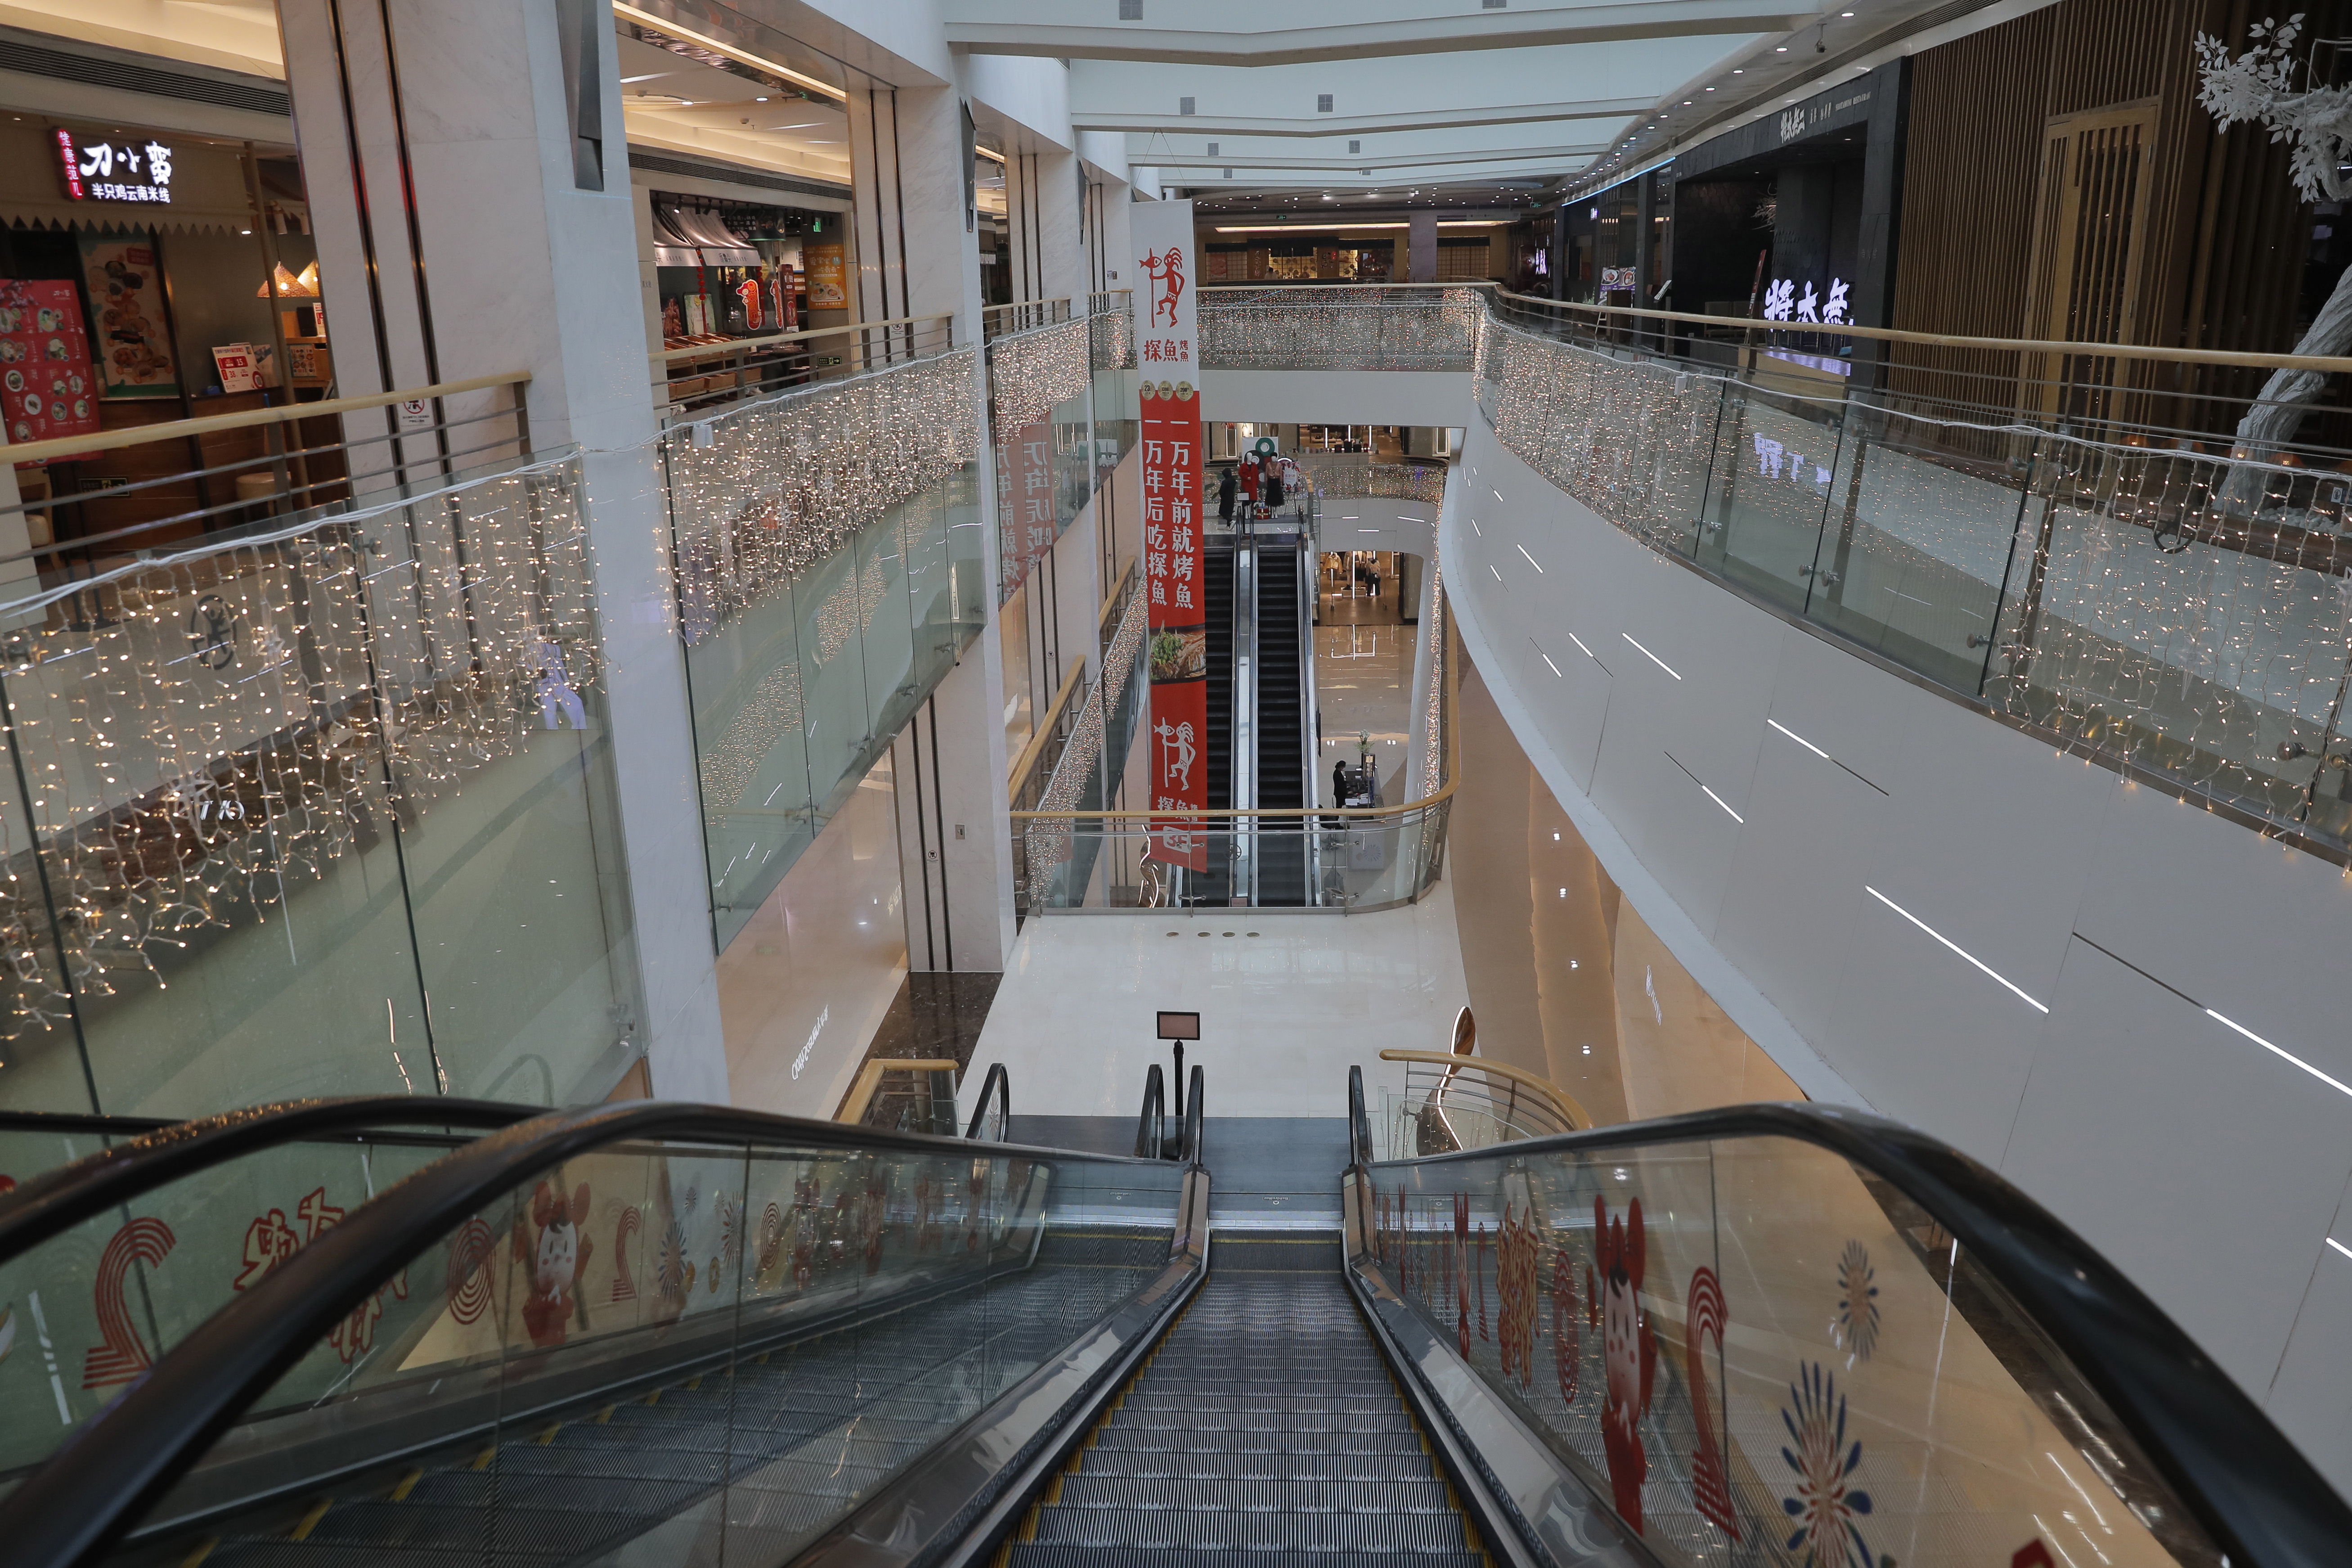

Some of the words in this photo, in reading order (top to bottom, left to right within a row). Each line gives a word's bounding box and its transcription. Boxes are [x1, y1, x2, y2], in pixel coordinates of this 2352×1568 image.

[79, 141, 172, 185] 刀小蛮
[91, 183, 171, 203] 半只鸡云南米线
[1144, 339, 1178, 362] 探魚
[1180, 340, 1189, 362] 烤魚
[1145, 420, 1168, 606] 一万年后吃探魚
[1170, 421, 1195, 609] 一万年前就烤魚
